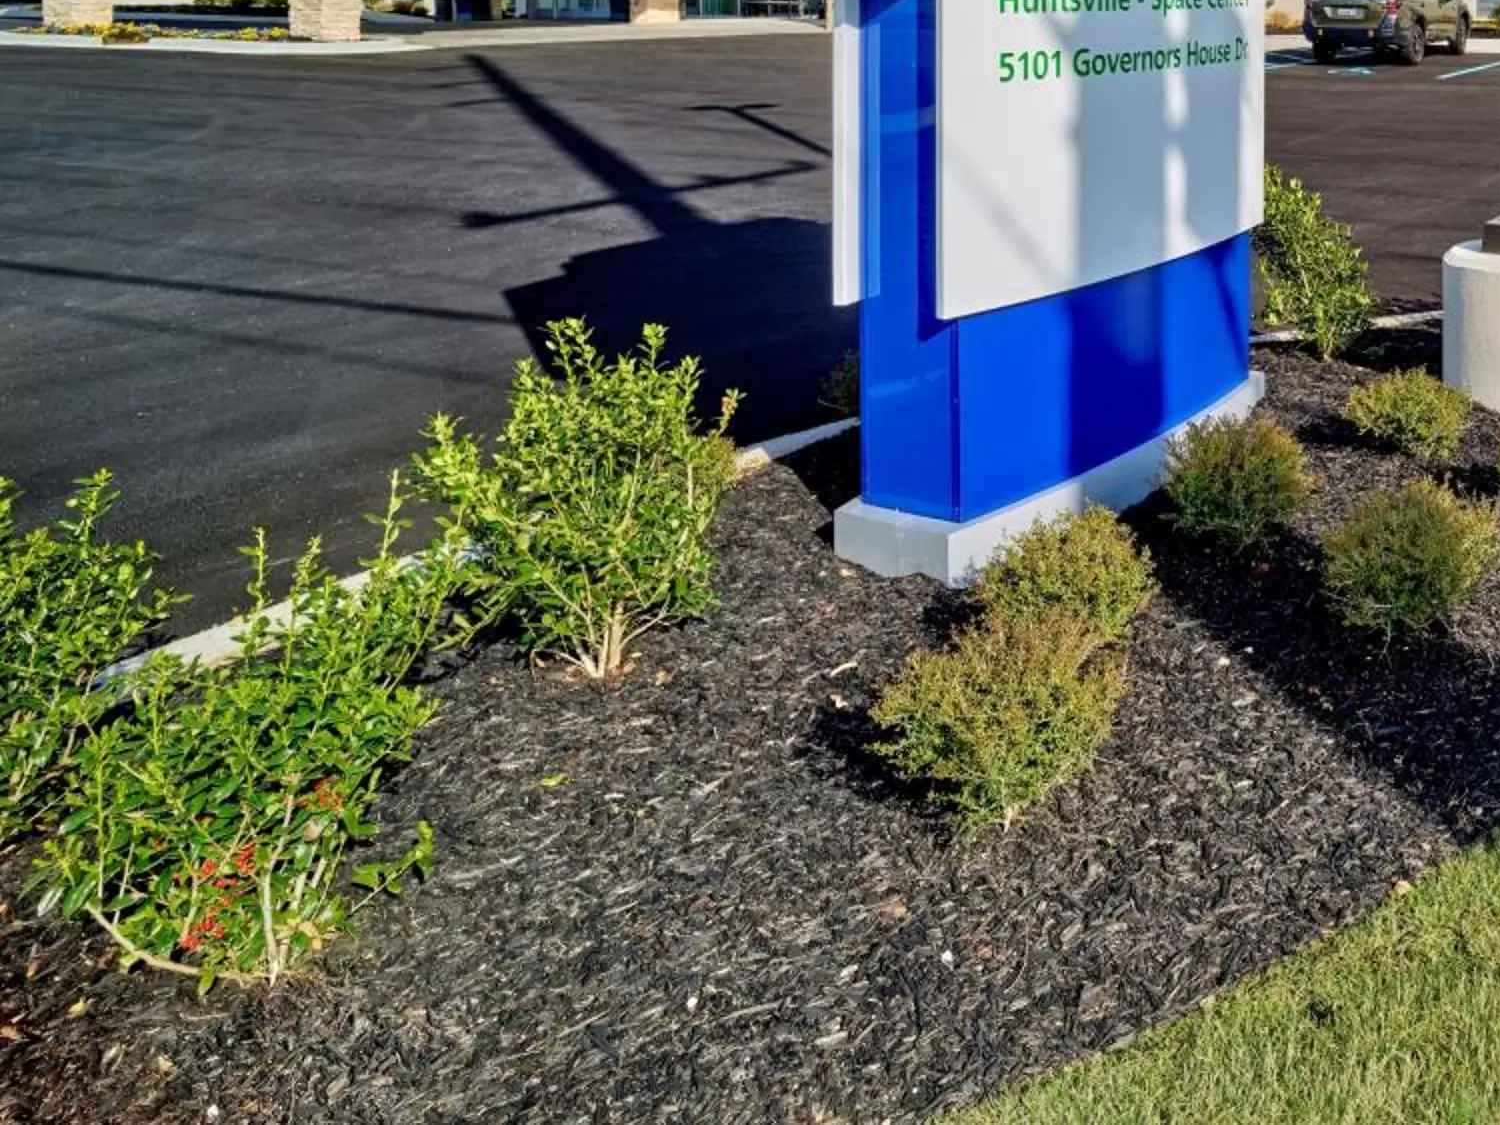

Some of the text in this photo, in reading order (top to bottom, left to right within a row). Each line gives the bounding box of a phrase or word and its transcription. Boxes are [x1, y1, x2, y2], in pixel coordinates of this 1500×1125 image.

[999, 37, 1248, 83] 5101 Governors House Dr
